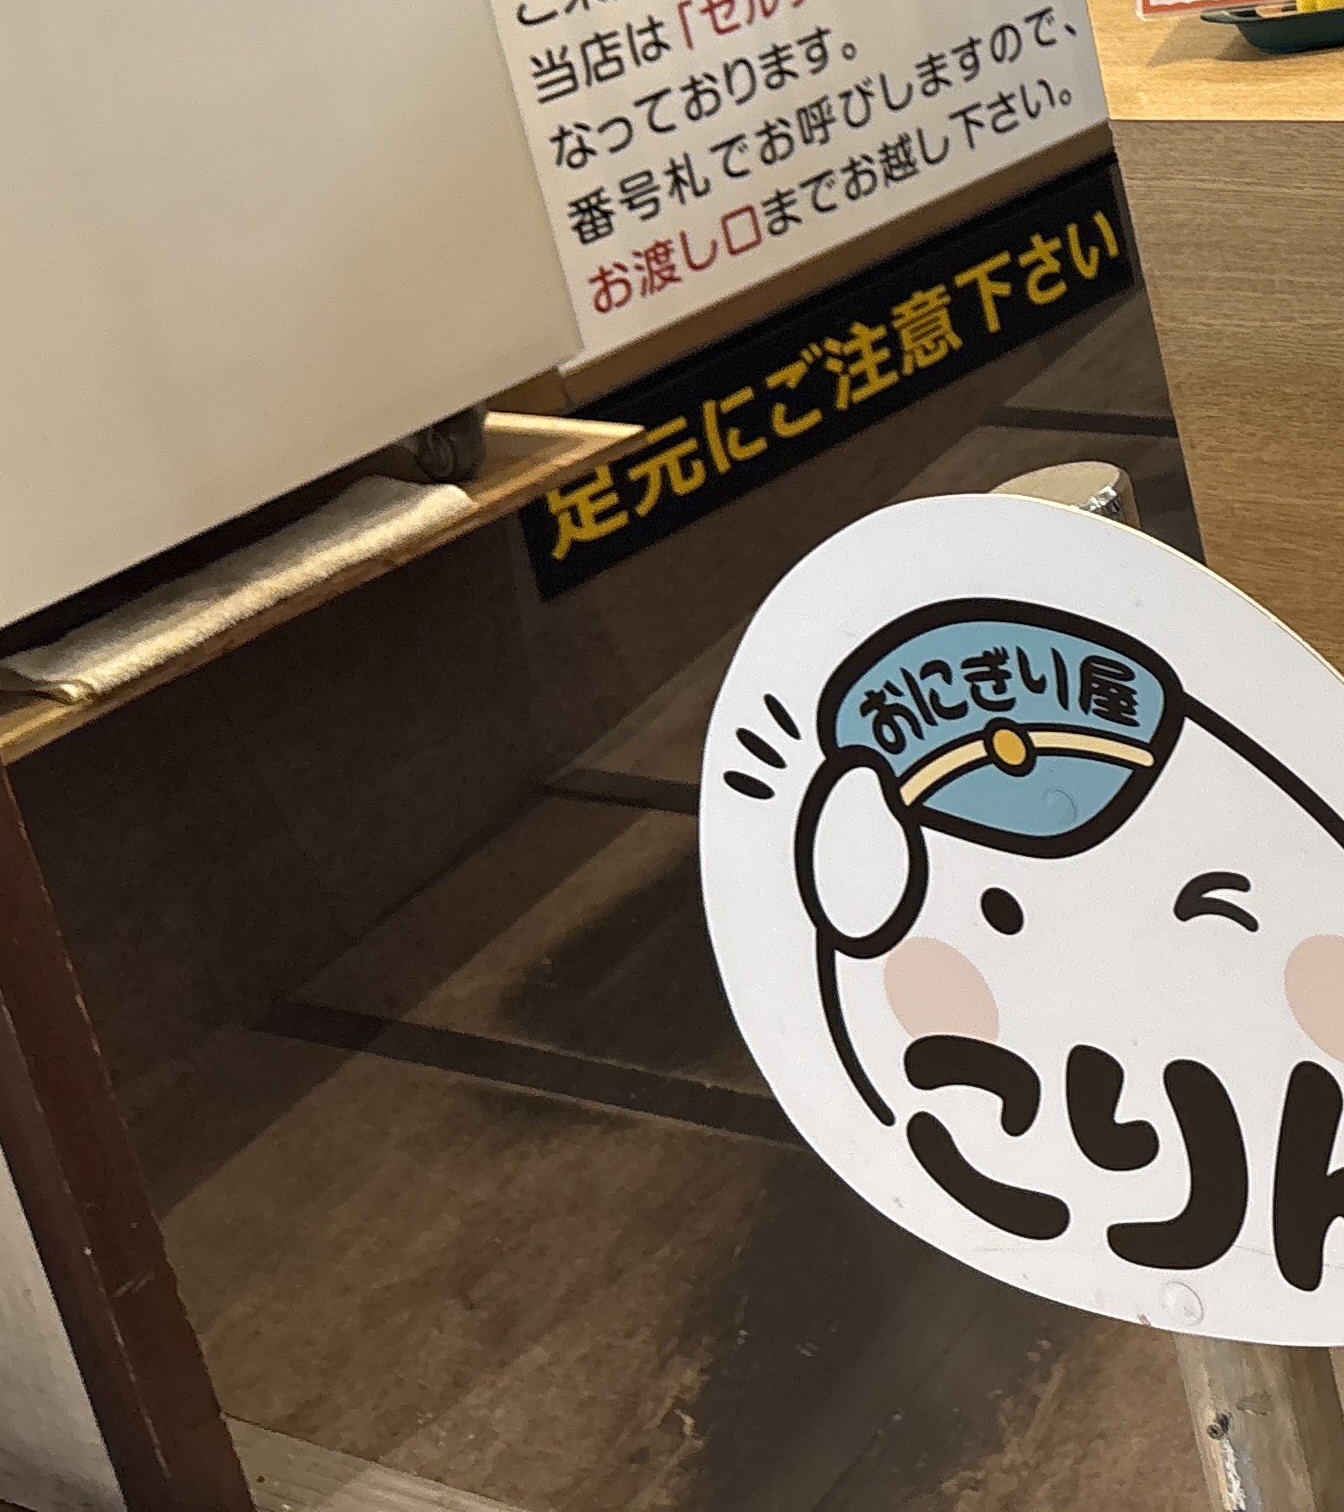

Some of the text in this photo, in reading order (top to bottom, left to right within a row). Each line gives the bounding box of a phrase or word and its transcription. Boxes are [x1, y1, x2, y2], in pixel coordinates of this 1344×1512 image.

[551, 25, 858, 170] なっております。
[567, 7, 1078, 247] 番号札でお呼びしますので、
[587, 78, 1073, 313] お渡し口までお越し下さい。
[547, 212, 1120, 561] 足元にご注意下さい
[859, 646, 1141, 755] おにぎり屋
